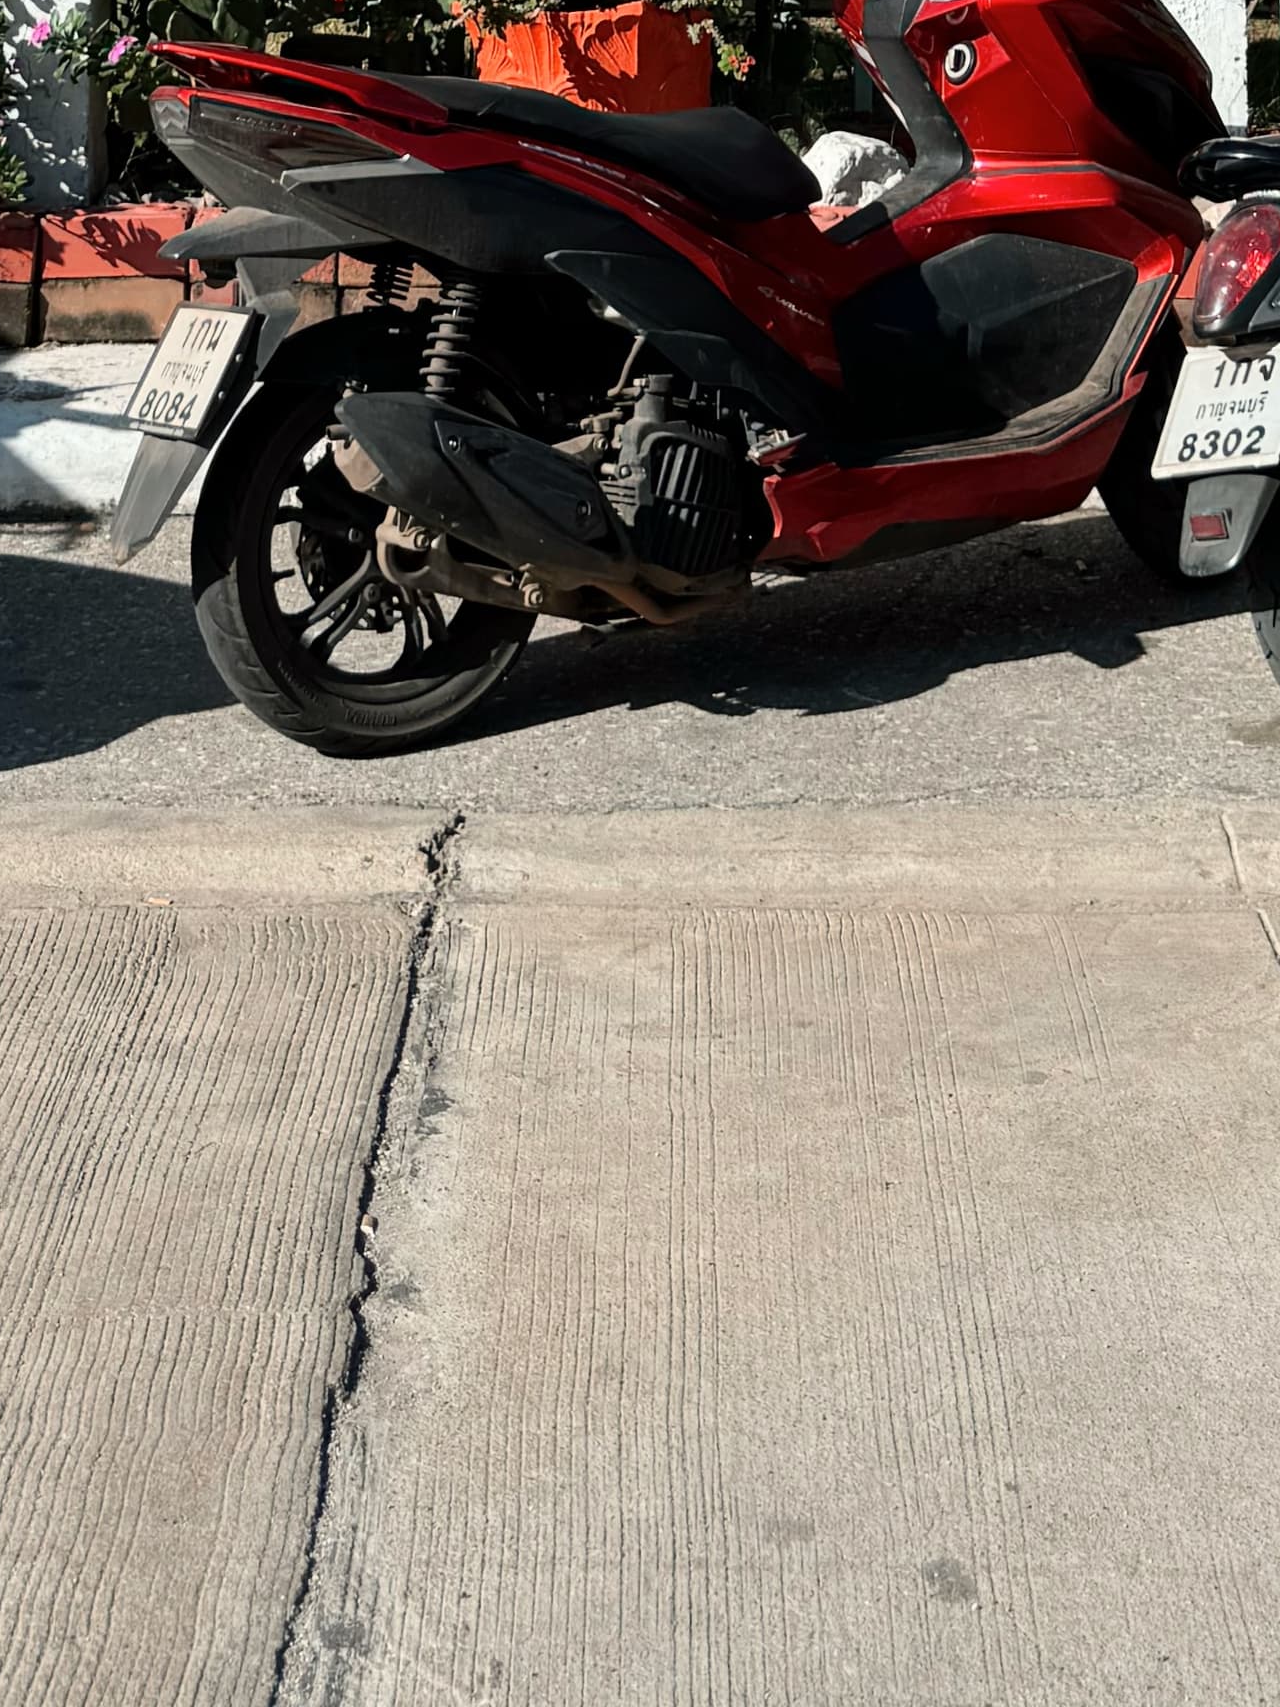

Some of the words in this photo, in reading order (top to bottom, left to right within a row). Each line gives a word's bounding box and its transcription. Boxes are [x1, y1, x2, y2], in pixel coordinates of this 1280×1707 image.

[138, 388, 198, 427] 8084
[1195, 390, 1270, 421] กาญจนบุรี
[1178, 425, 1266, 463] 8302
